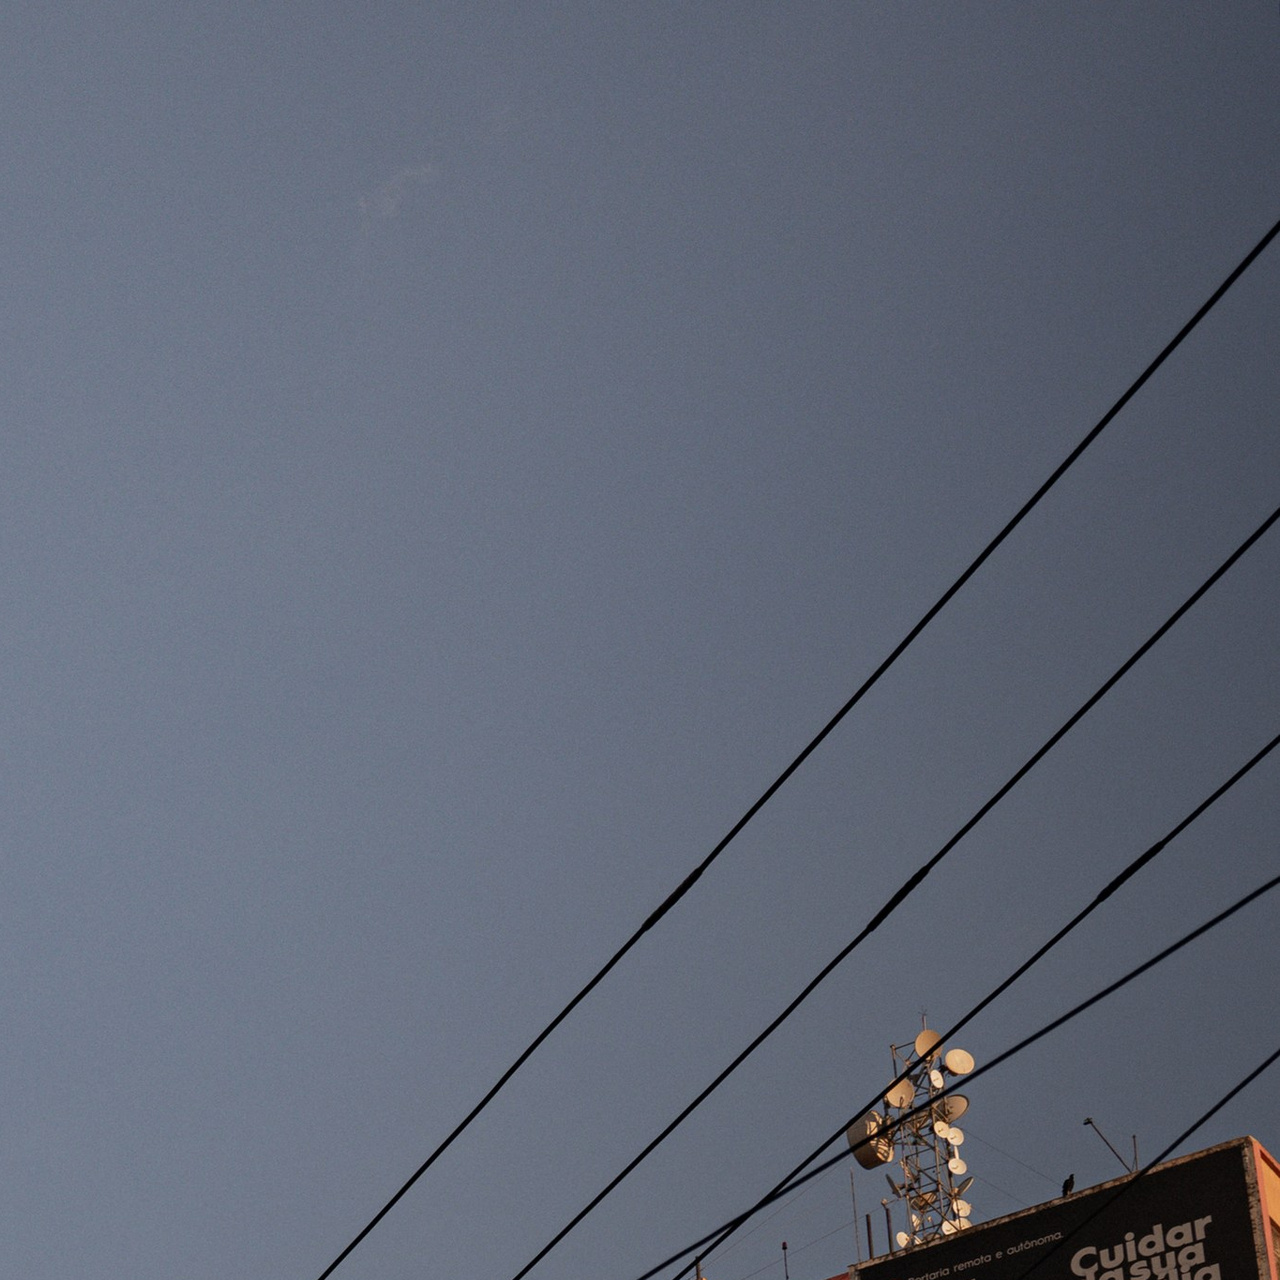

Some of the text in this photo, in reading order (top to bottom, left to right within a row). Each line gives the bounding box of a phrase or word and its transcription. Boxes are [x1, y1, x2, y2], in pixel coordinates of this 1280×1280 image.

[953, 1254, 992, 1273] remota
[995, 1249, 1003, 1260] e
[1006, 1230, 1064, 1256] autônoma.
[1070, 1214, 1213, 1277] Cuidar
